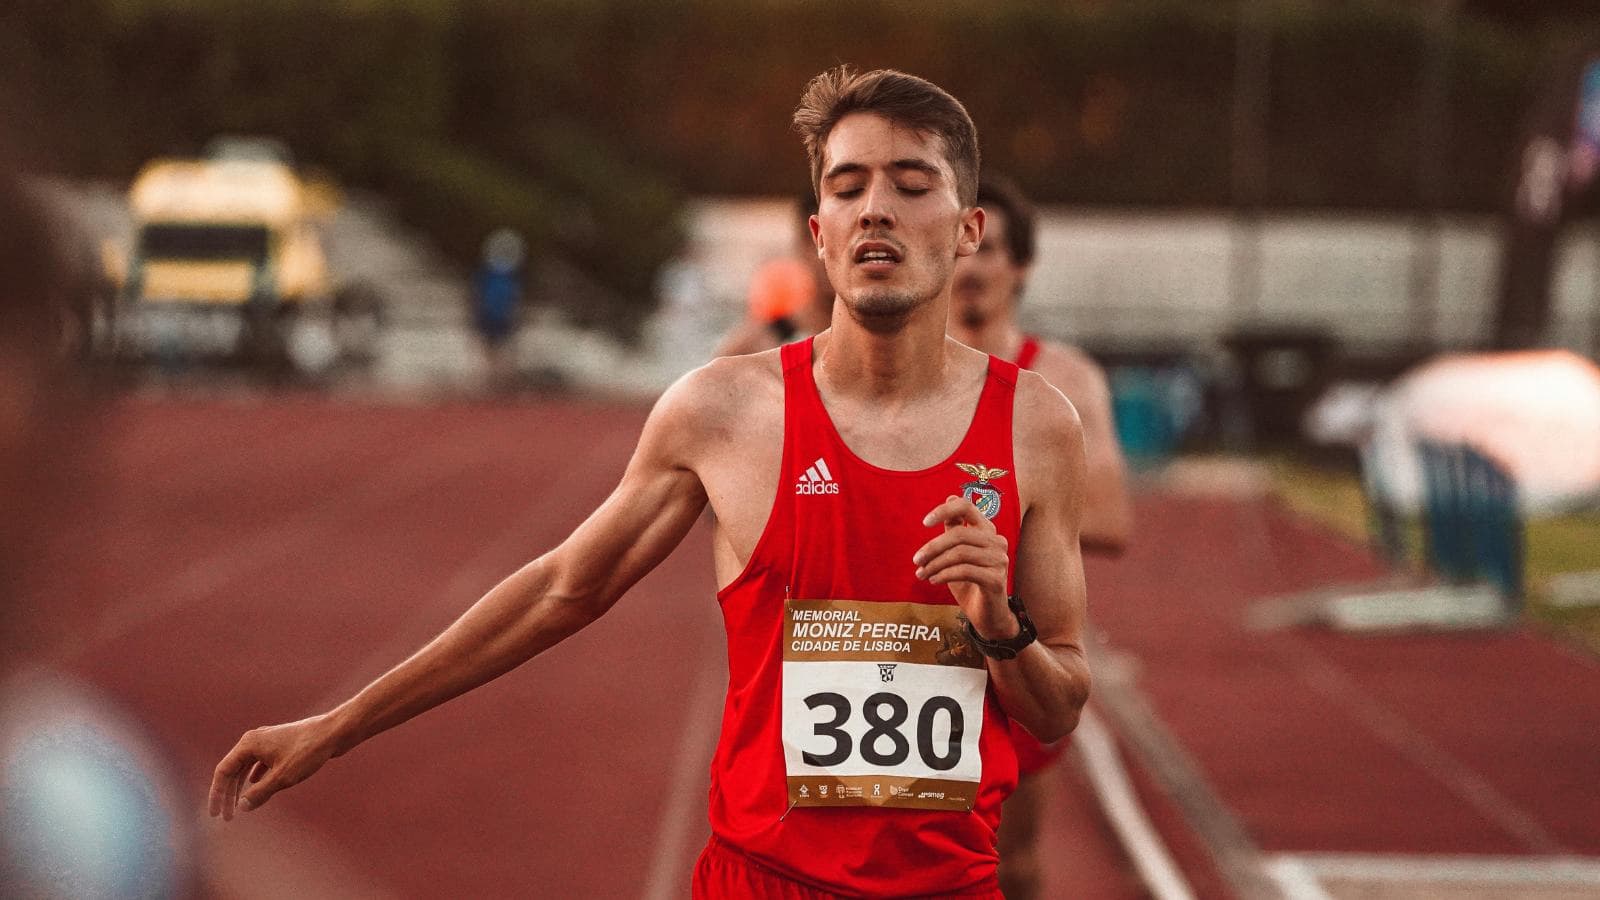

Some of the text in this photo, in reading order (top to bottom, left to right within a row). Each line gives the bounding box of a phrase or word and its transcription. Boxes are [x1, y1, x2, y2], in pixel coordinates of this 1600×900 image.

[795, 481, 839, 495] adidas
[792, 610, 861, 621] MEMORIAL
[792, 623, 941, 641] MONIZ PEREIRA
[791, 641, 911, 653] CIDADE DE LISBOA
[802, 692, 965, 771] 380
